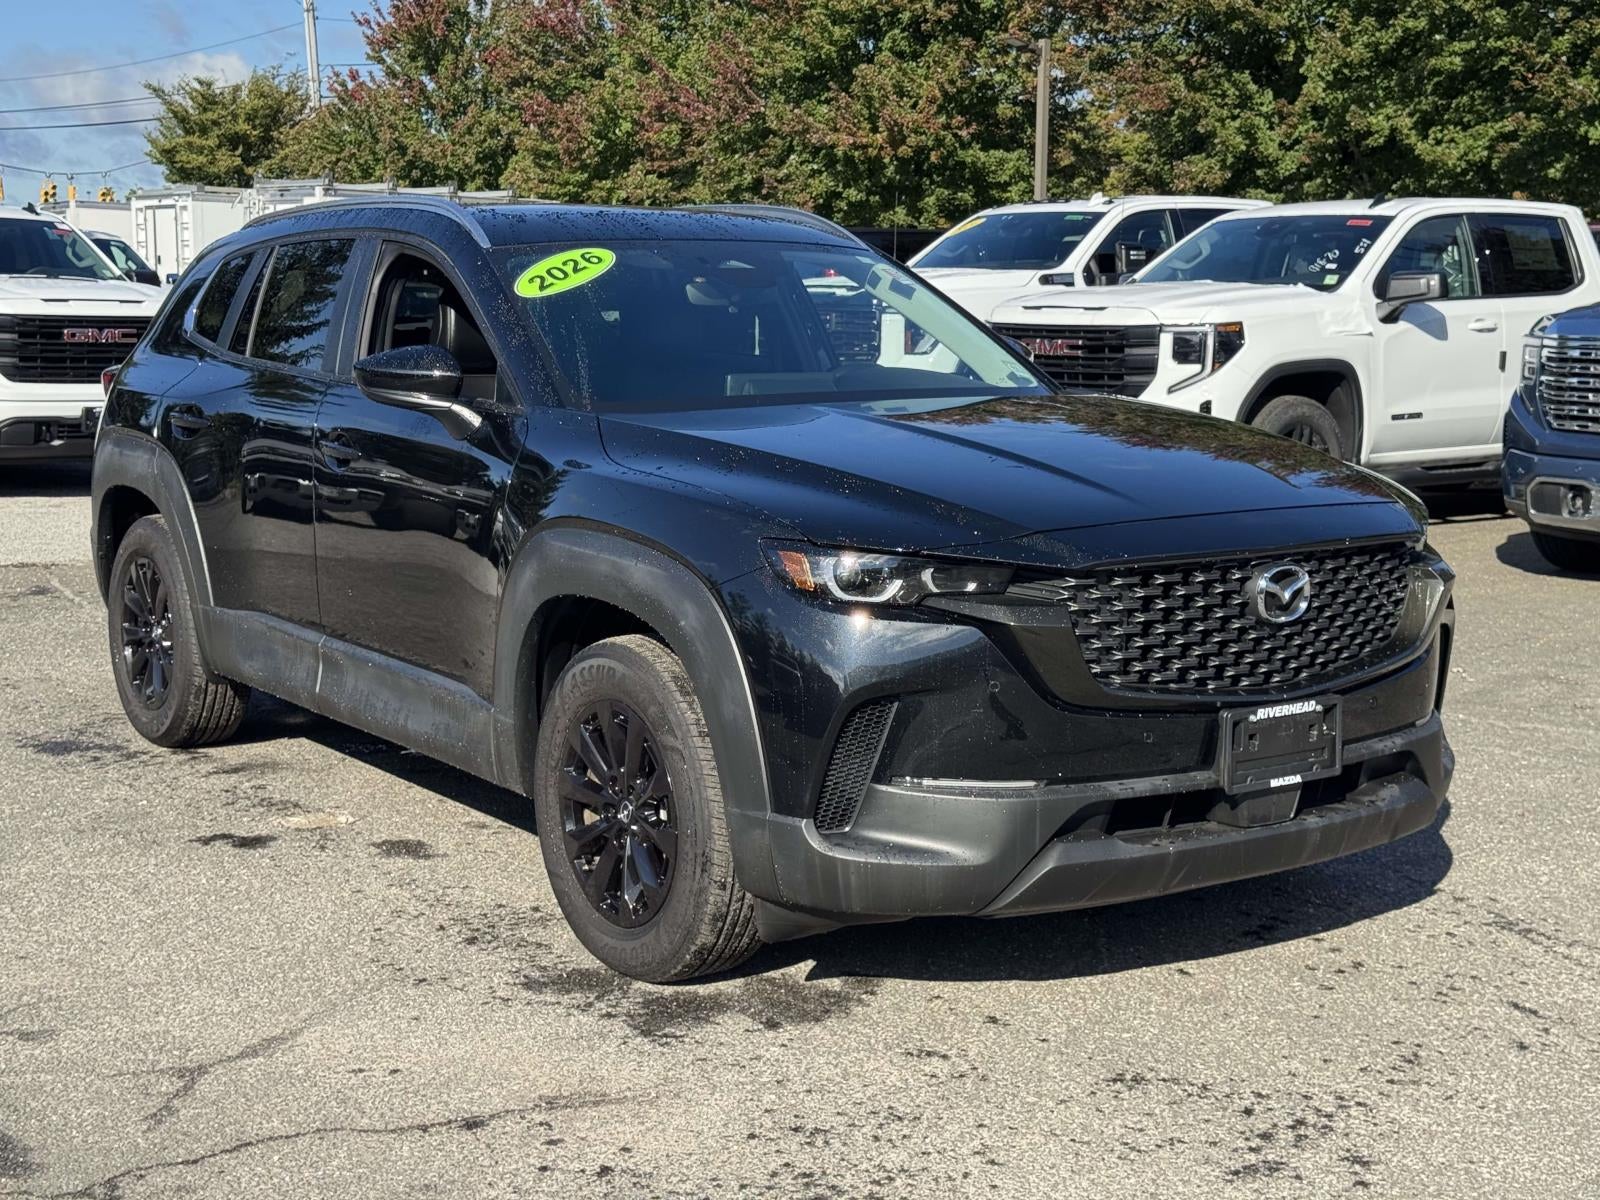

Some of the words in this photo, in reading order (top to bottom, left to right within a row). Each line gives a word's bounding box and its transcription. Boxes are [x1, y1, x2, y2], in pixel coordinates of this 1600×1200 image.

[528, 252, 603, 292] 2026
[64, 328, 138, 343] GMC
[1256, 700, 1316, 720] RIVERHEAD
[1270, 775, 1302, 787] MAZDA
